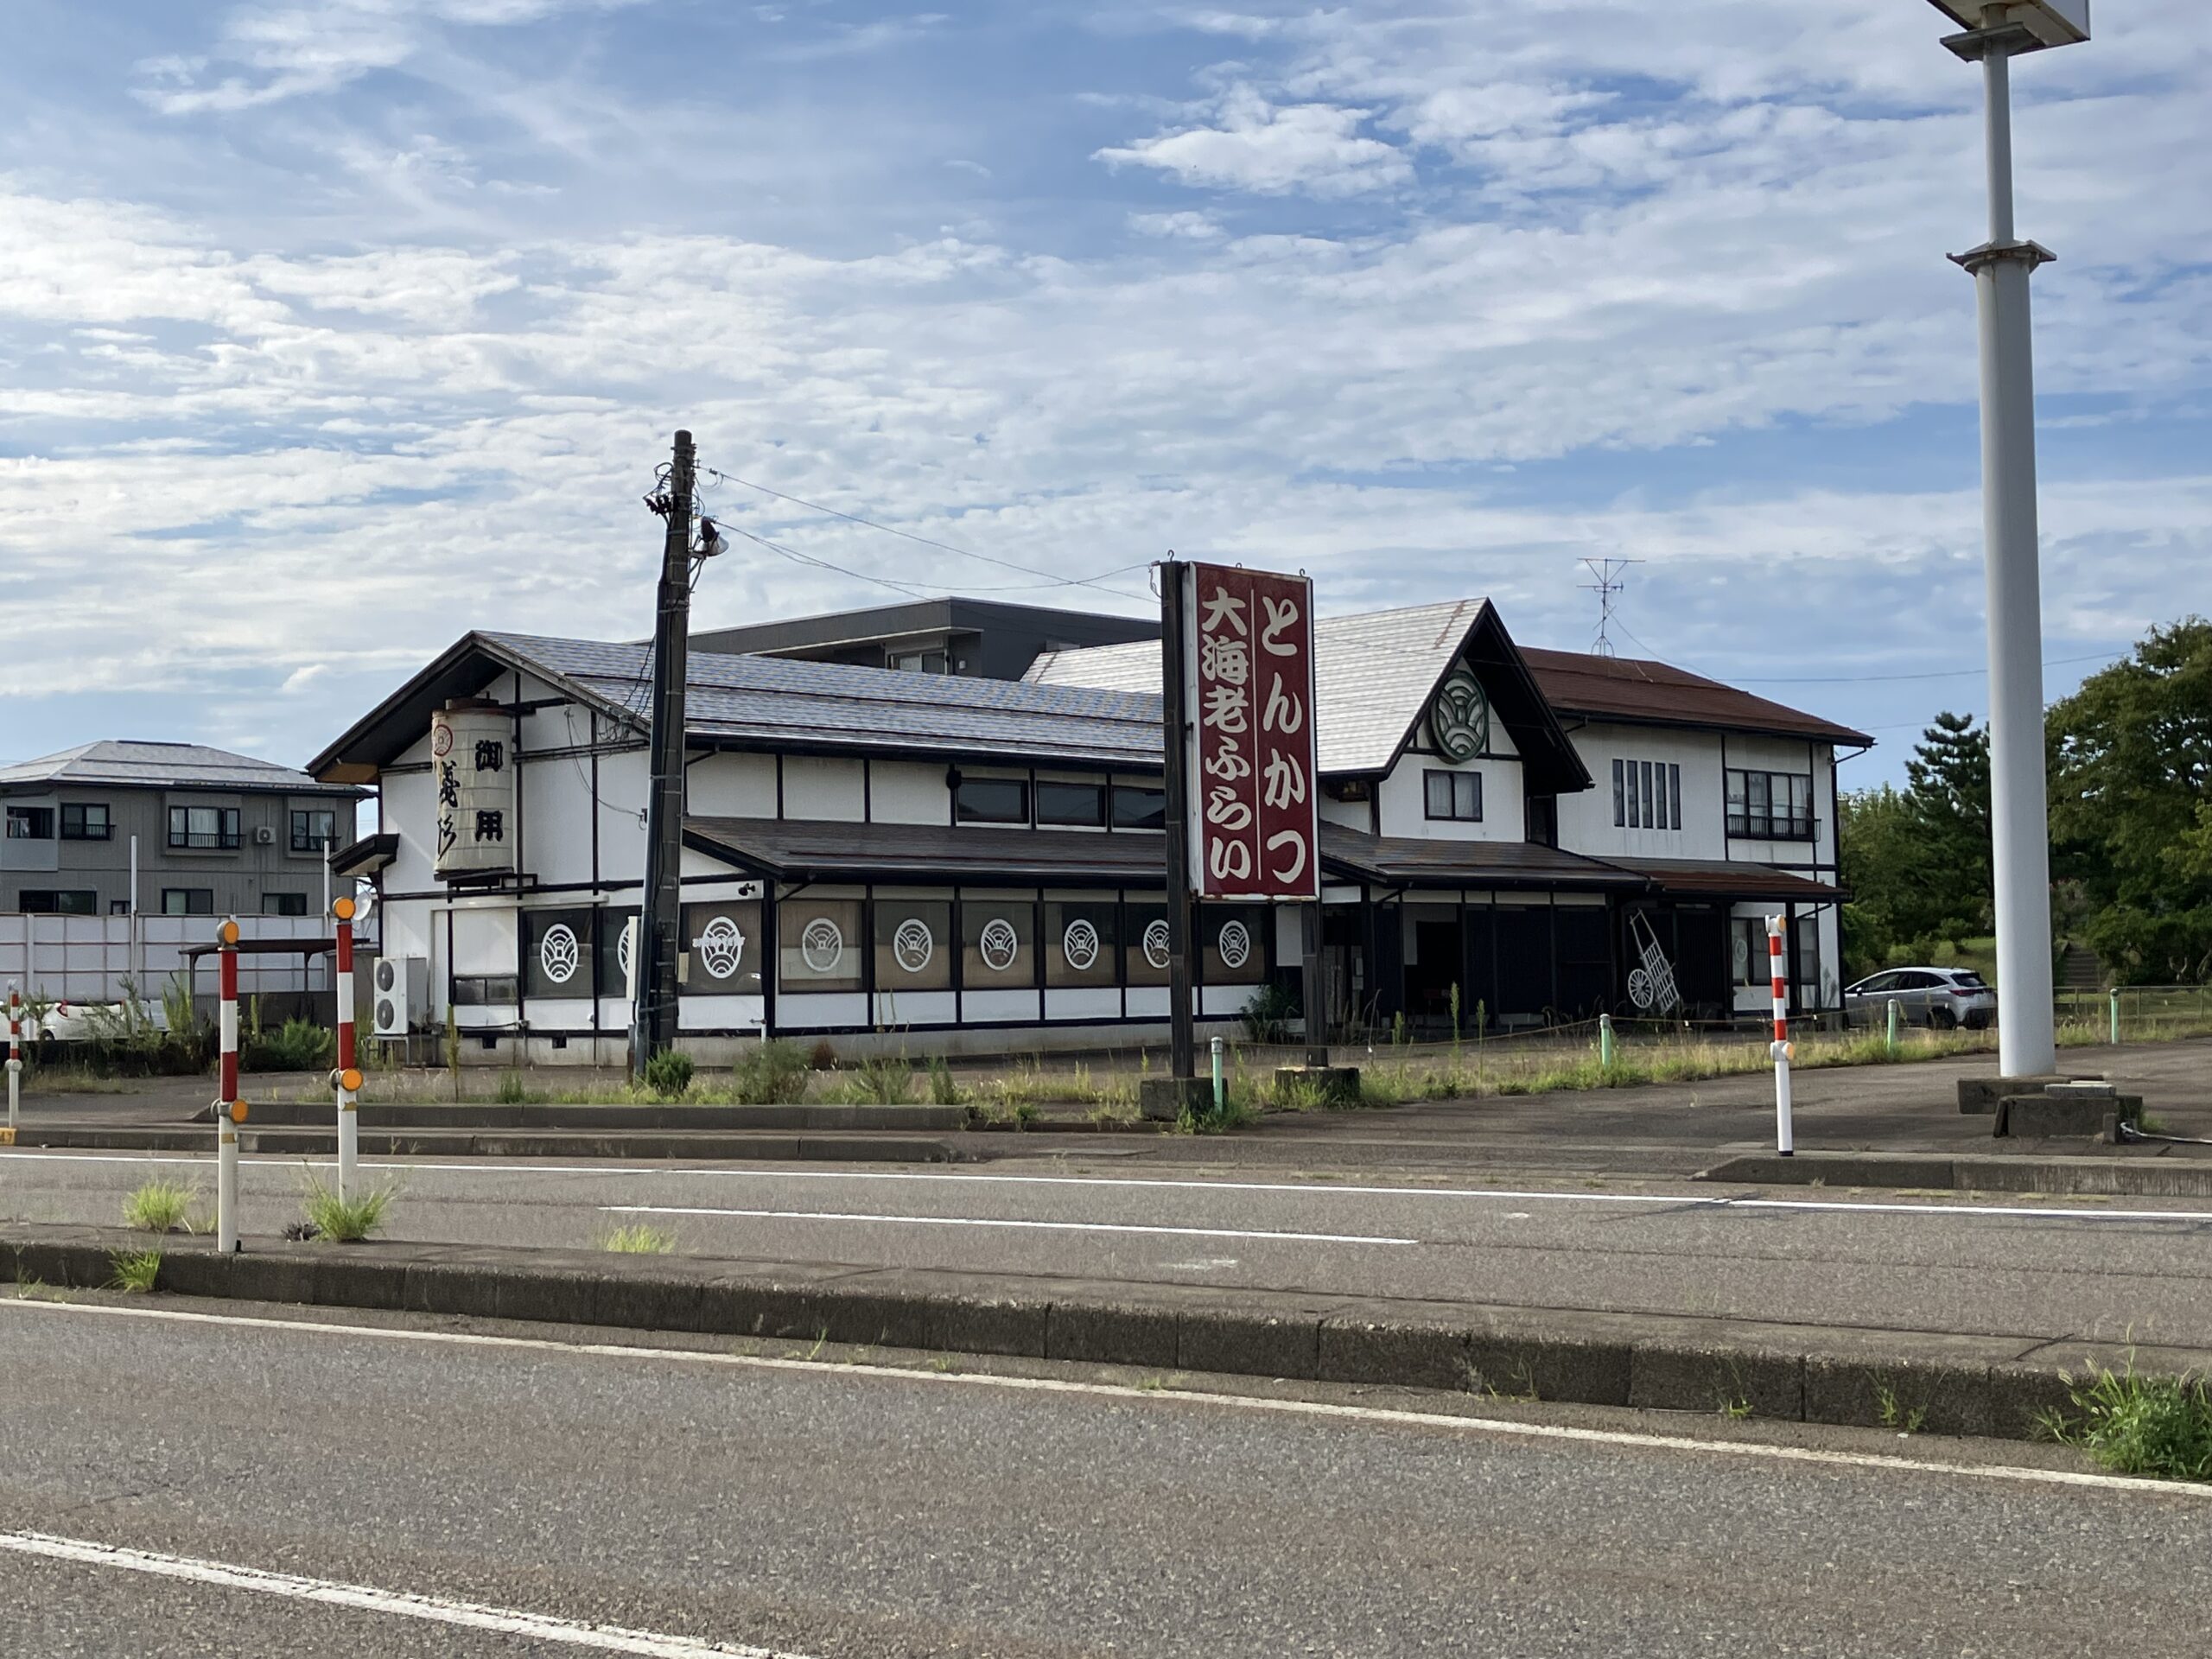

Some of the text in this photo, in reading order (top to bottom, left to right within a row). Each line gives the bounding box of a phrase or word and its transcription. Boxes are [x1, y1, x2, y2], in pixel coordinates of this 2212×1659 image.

[1202, 587, 1252, 880] 大海老ふらい
[1262, 596, 1306, 884] とんかつ
